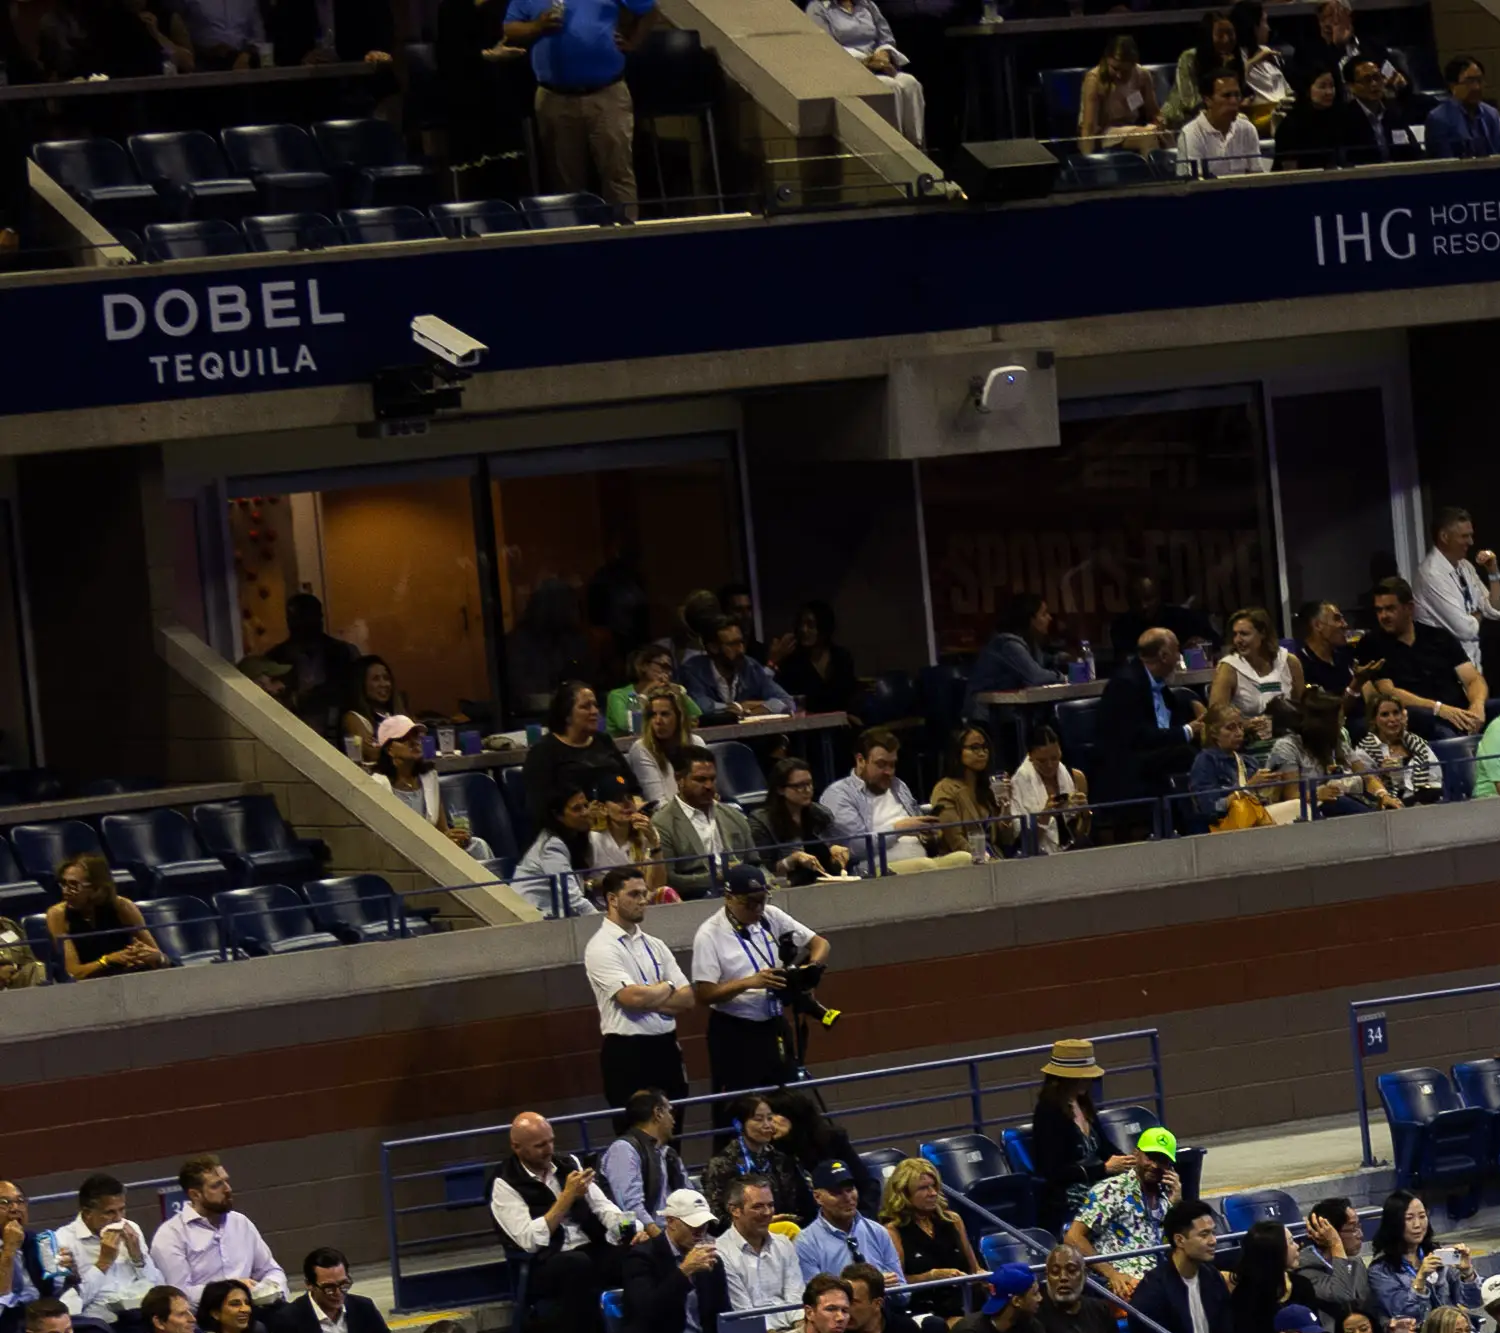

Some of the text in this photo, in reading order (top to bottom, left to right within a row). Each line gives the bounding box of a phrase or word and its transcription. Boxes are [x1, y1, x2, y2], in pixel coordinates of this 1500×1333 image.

[1315, 207, 1415, 265] IHG
[104, 278, 345, 340] DOBEL
[149, 344, 318, 383] TEQUILA
[1367, 1026, 1383, 1046] 34
